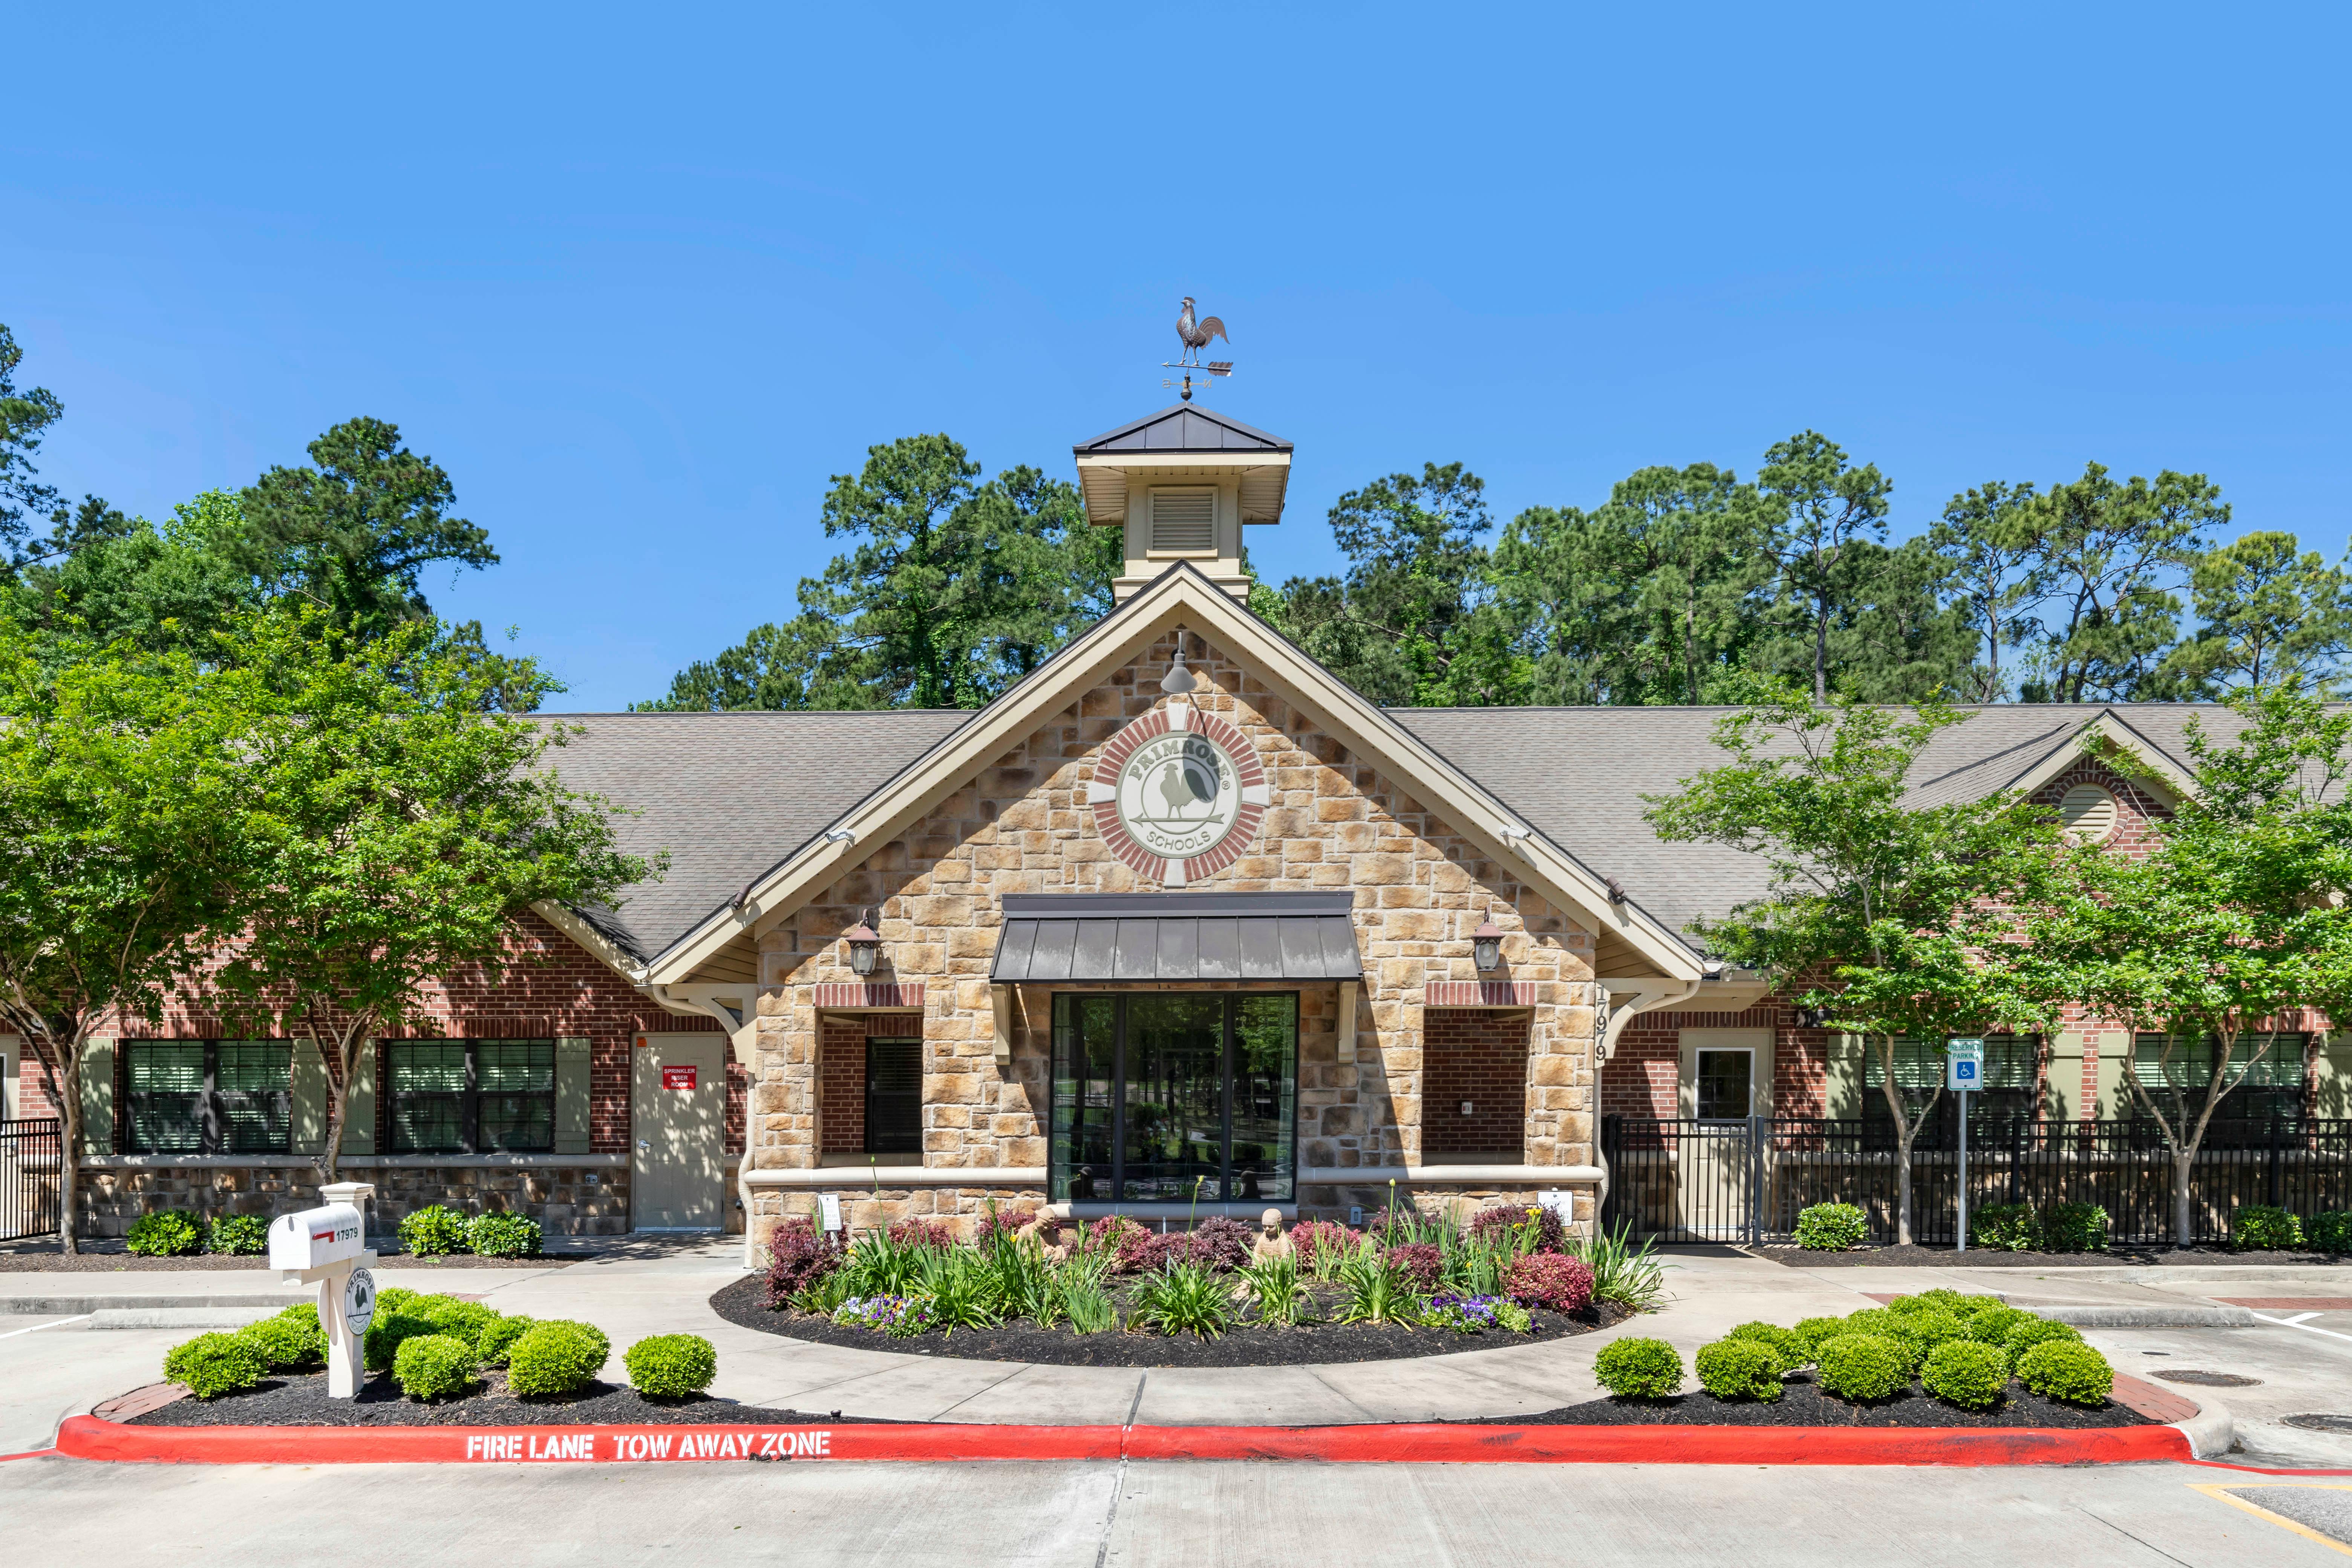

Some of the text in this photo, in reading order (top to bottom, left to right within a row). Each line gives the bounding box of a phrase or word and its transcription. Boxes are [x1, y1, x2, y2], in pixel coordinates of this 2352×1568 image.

[1129, 740, 1230, 780] PRIMROSE
[1147, 831, 1211, 850] SCHOOLS
[1596, 985, 1607, 1061] 17979
[337, 1227, 358, 1242] 17979
[347, 1271, 374, 1294] PRIMROSE
[351, 1320, 368, 1332] SCHOOLS
[468, 1431, 830, 1459] FIRE LANE TOW AWAY ZONE
